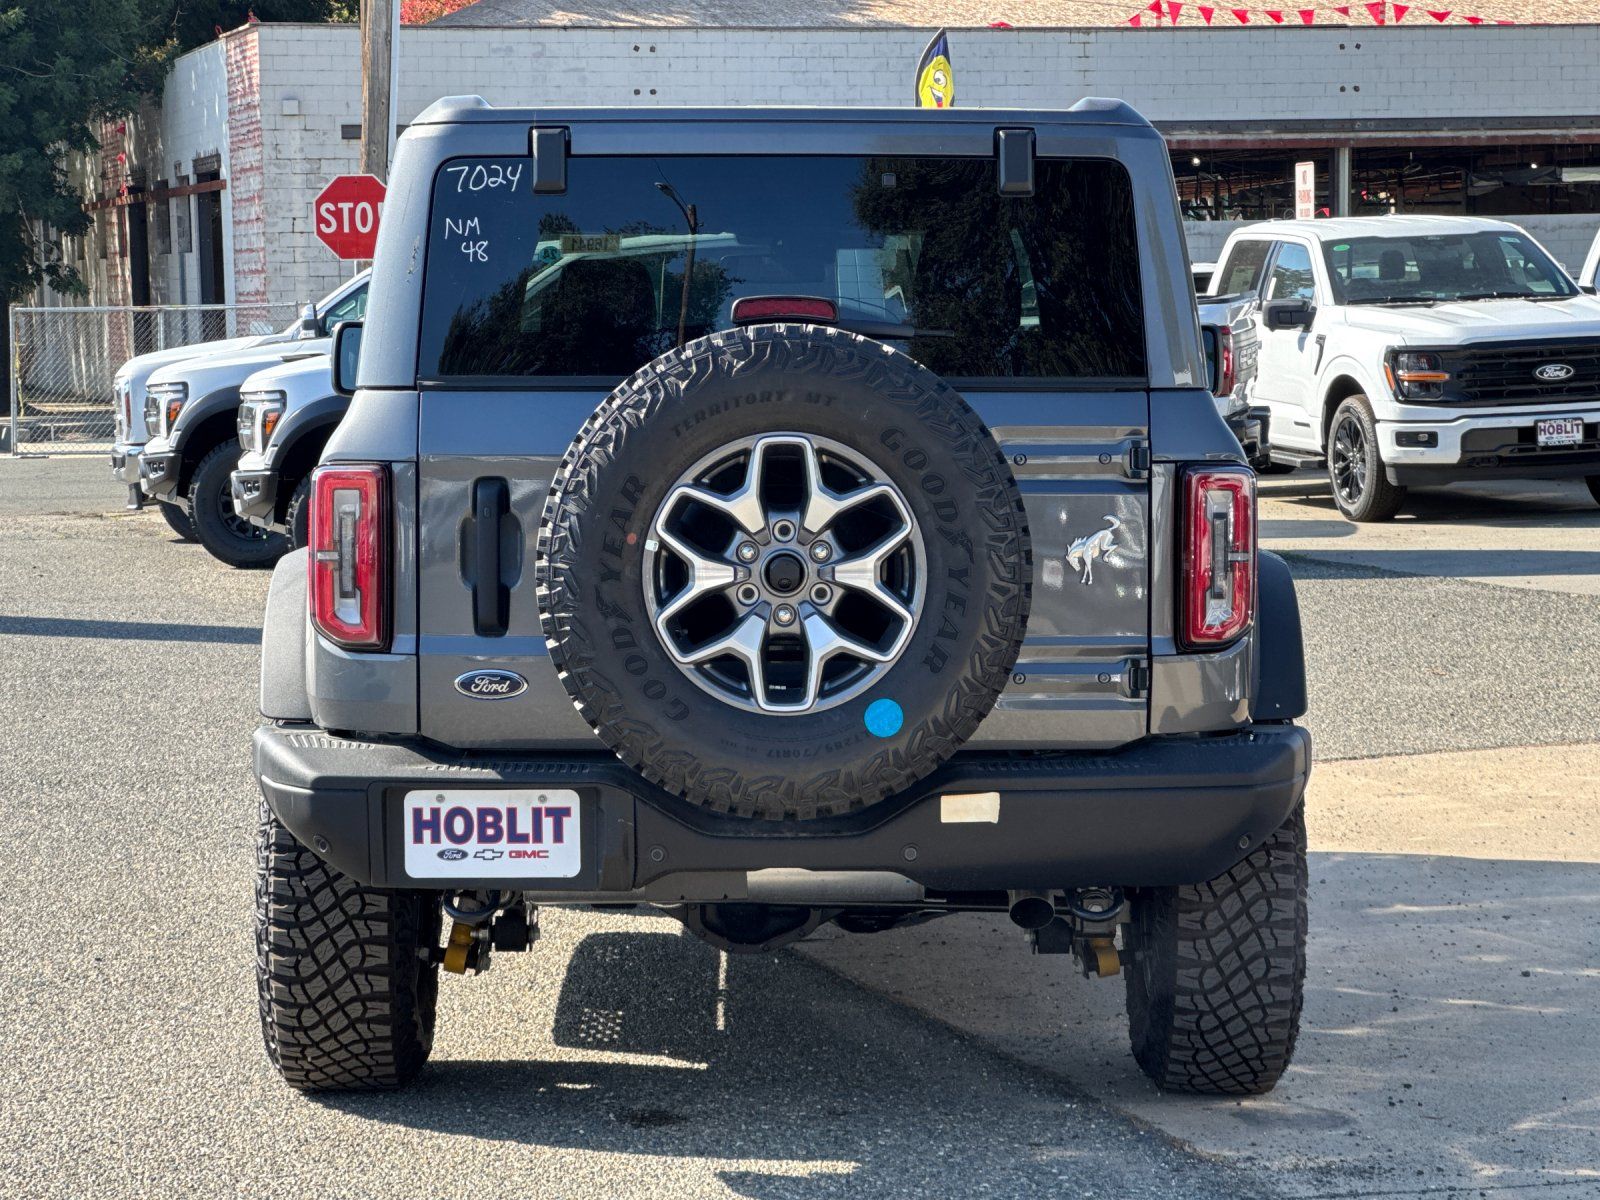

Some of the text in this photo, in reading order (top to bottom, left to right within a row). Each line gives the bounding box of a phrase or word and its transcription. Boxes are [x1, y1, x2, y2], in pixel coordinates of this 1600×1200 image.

[446, 163, 522, 192] 7024
[319, 202, 384, 234] STO
[444, 216, 480, 239] NM
[461, 240, 489, 263] 48
[1543, 366, 1567, 377] Ford
[671, 390, 786, 438] TERRITORY
[1538, 423, 1582, 436] HOBLIT
[470, 675, 511, 693] Ford
[411, 806, 572, 845] HOBLIT
[442, 849, 549, 860] Ford GMC
